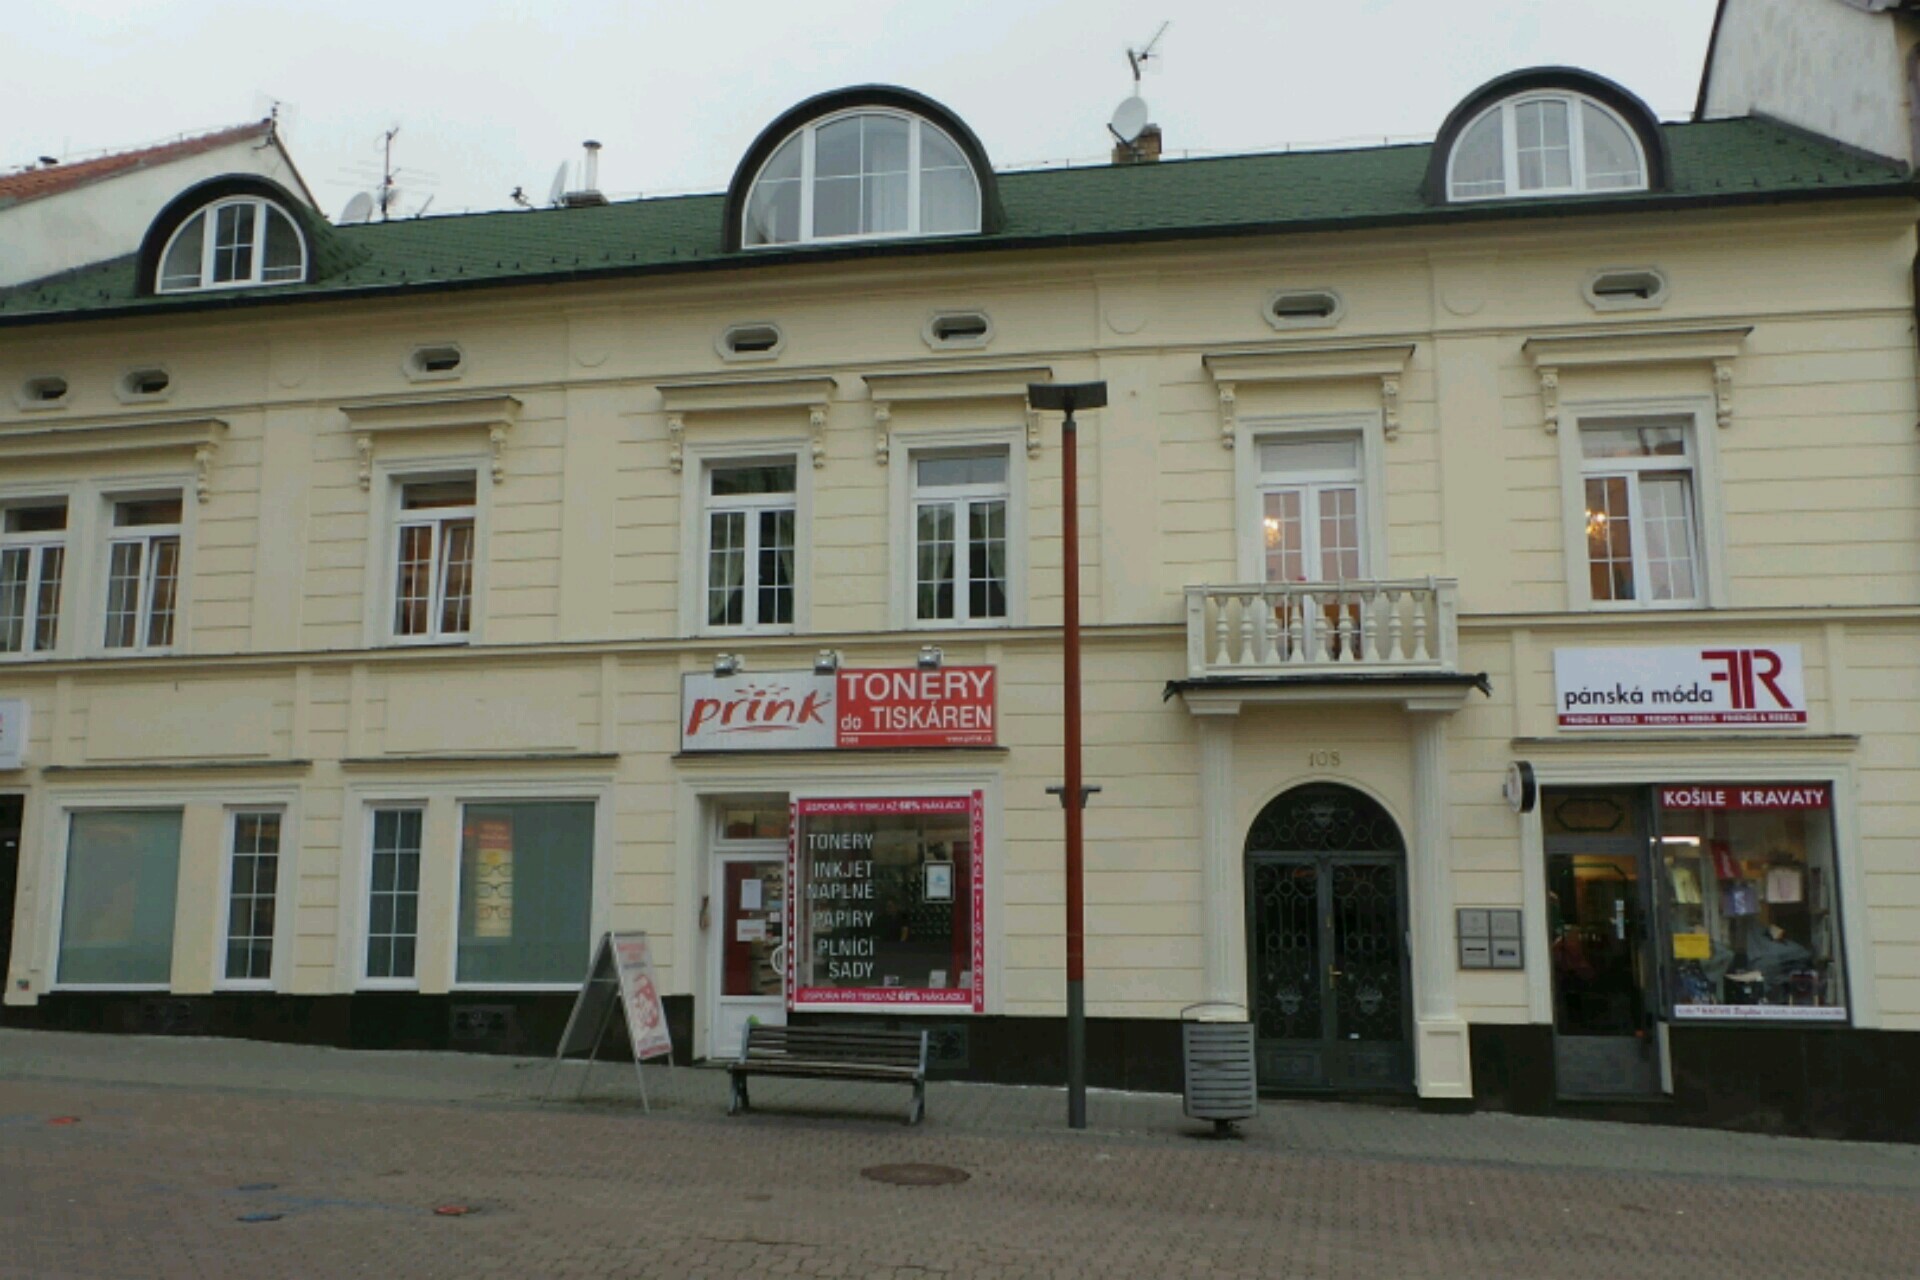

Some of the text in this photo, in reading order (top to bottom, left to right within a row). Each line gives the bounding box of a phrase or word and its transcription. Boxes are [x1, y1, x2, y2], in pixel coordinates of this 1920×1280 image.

[841, 670, 992, 701] TONERY
[1564, 682, 1713, 711] pánská móda
[686, 688, 832, 736] prink
[840, 700, 992, 731] do TISKÁREN
[1308, 750, 1340, 767] 108
[1664, 787, 1824, 806] KOŠILE KRAVATY
[807, 833, 874, 849] TONERY
[814, 860, 874, 878] INKJET
[828, 961, 874, 979] SADY
